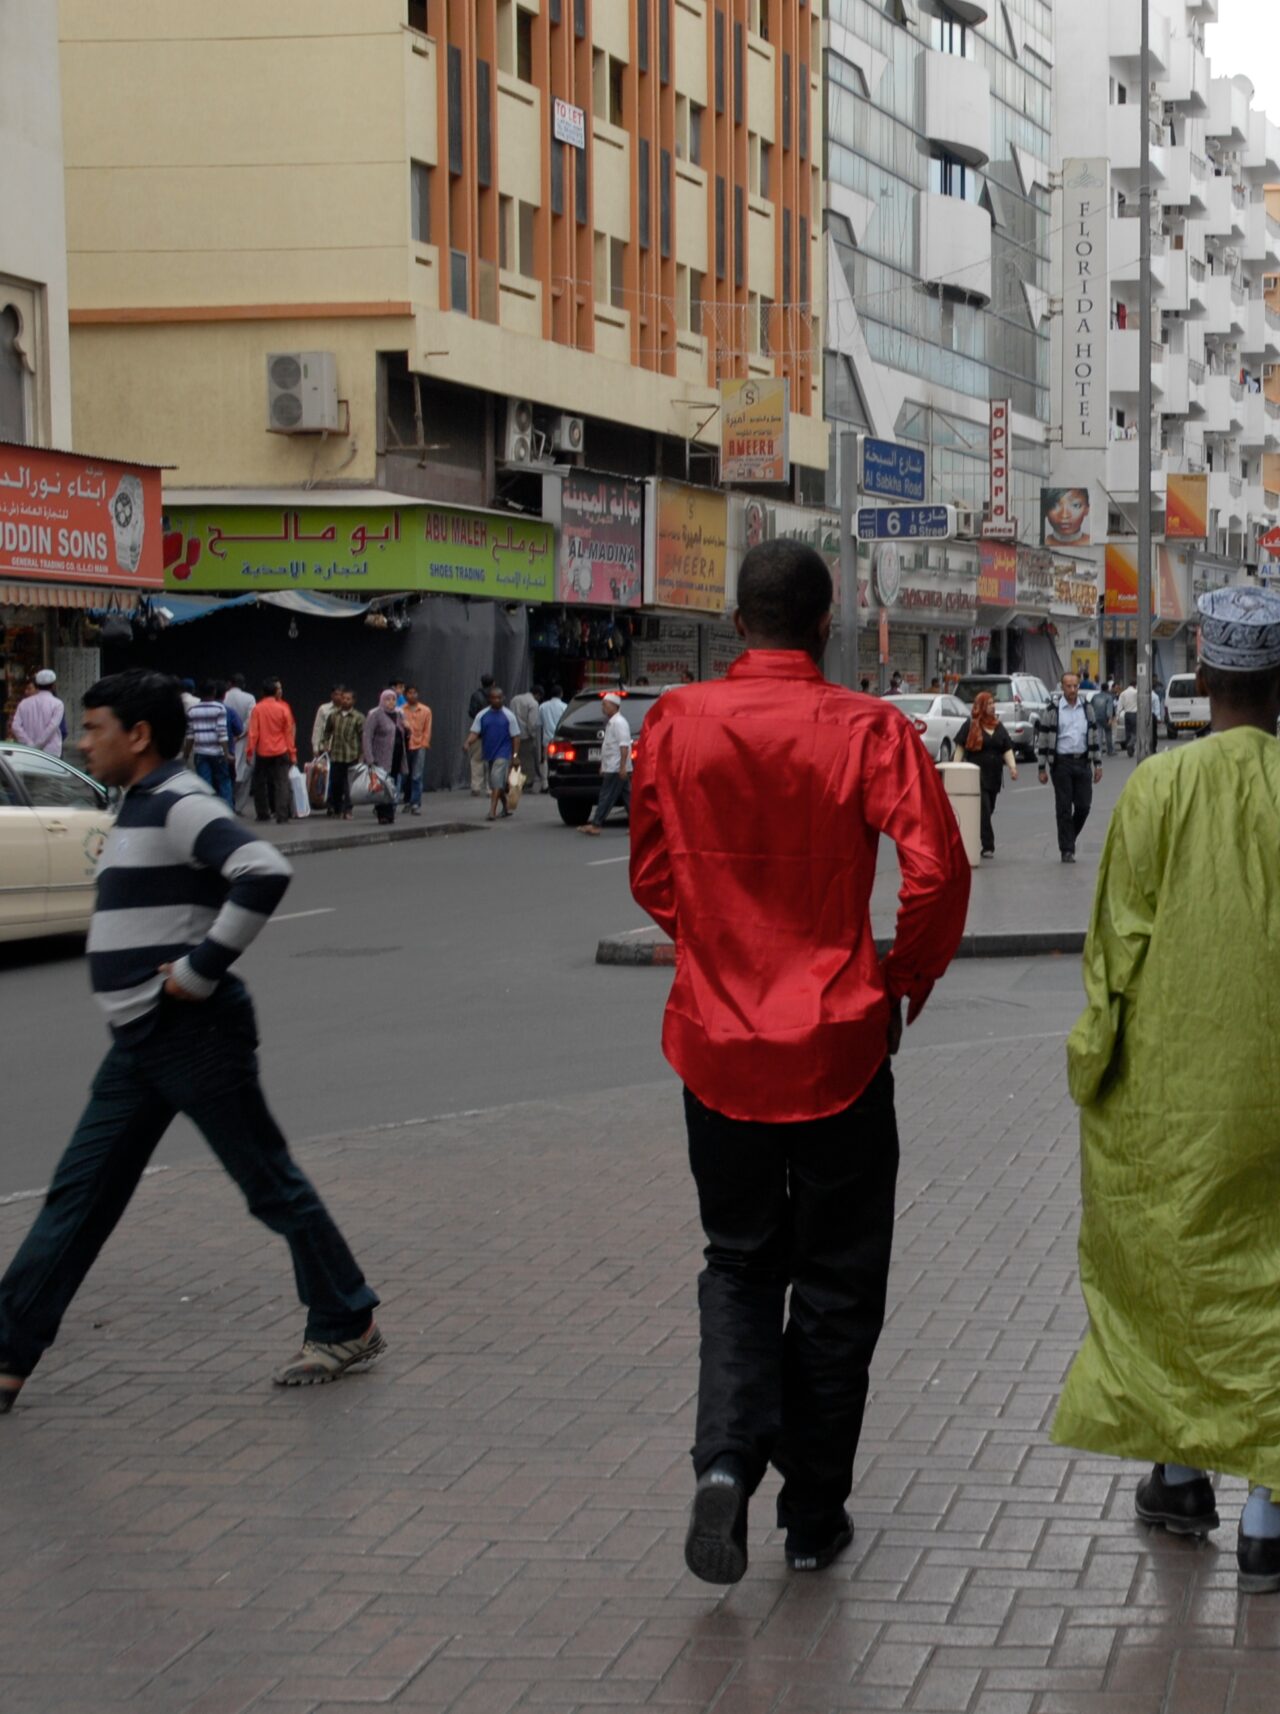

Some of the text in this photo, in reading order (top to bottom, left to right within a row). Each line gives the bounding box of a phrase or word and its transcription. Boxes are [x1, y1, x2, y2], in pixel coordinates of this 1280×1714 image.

[556, 101, 566, 118] TO
[1074, 201, 1093, 437] FLORIDA HOTEL
[729, 439, 774, 456] AMEERA
[899, 454, 922, 476] شارع
[865, 470, 922, 497] Al Sabkha Road
[887, 511, 900, 535] 6
[919, 509, 947, 525] شارع
[208, 511, 400, 559] ابو مالح
[425, 512, 488, 547] ABU MALEH
[919, 525, 947, 537] Street
[58, 527, 108, 561] SONS
[568, 540, 636, 564] AL MADINA
[11, 556, 39, 568] GENERAL
[40, 559, 65, 570] TRADING
[430, 562, 486, 582] SHOES TRADING
[1260, 564, 1274, 576] AL
